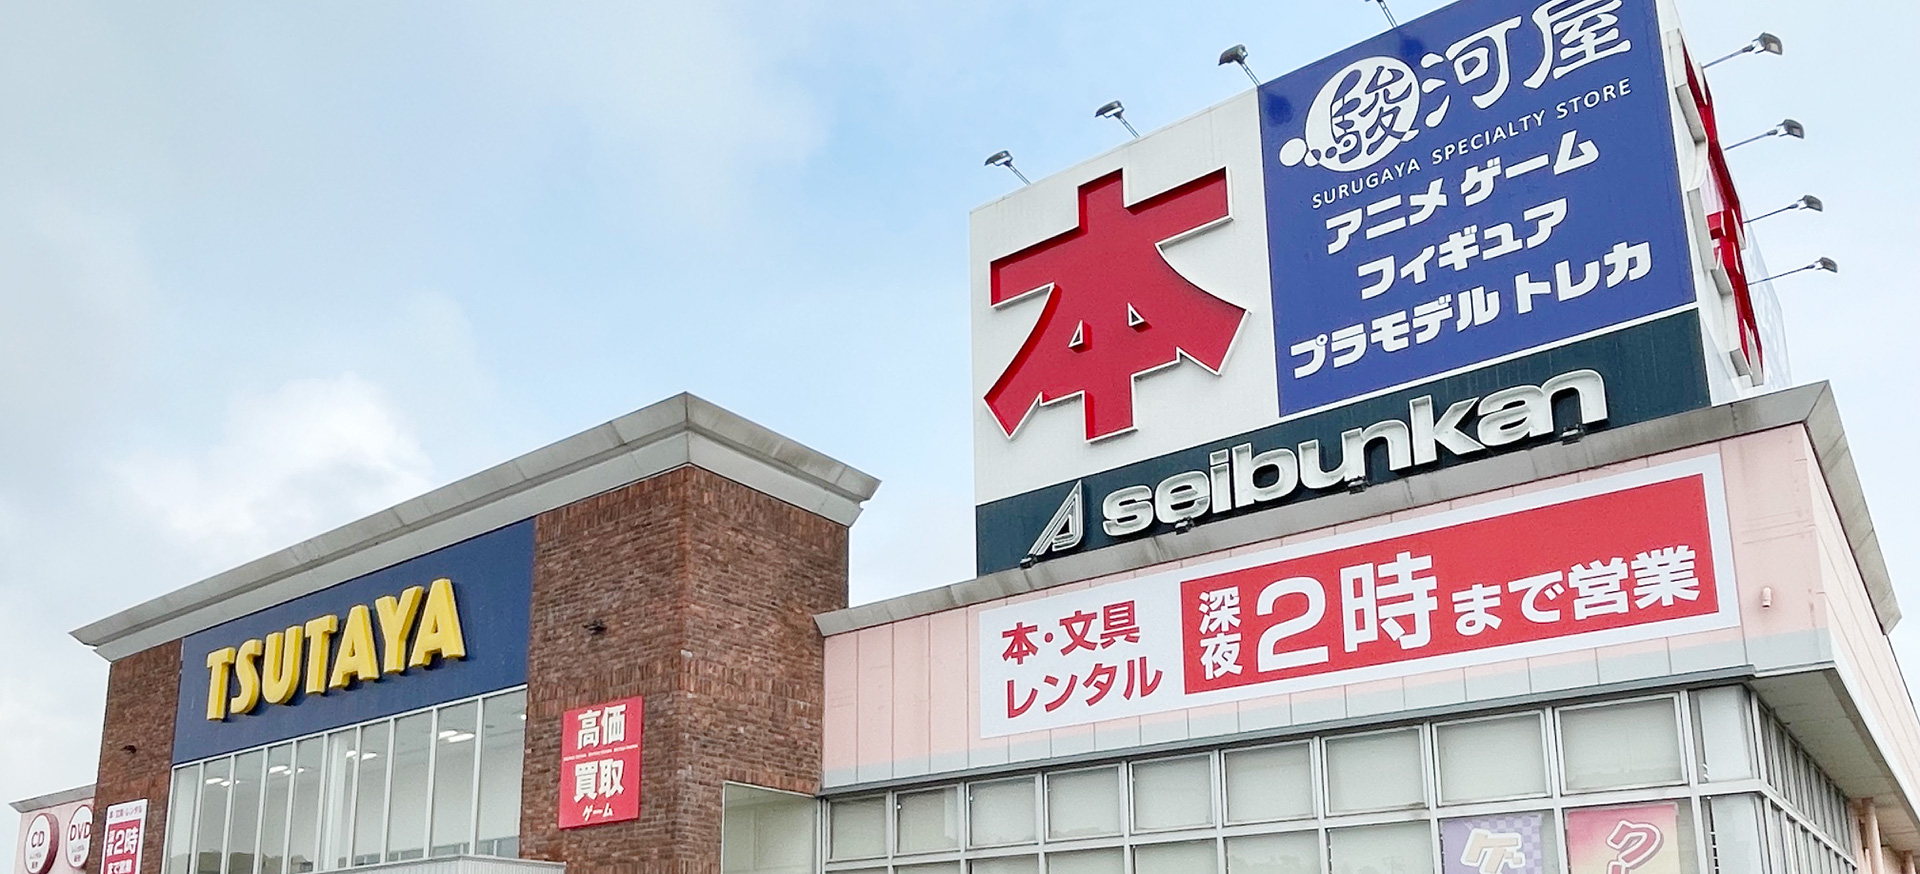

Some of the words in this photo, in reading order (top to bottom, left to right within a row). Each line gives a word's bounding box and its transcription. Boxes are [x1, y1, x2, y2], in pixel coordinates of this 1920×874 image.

[1304, 0, 1632, 166] 駿河屋
[1312, 157, 1420, 209] SURUGAYA
[1432, 110, 1545, 165] SPECIALTY
[1556, 78, 1632, 119] STORE
[1326, 178, 1447, 254] アニメ
[1461, 130, 1599, 206] ゲーム
[1358, 198, 1567, 300] フィギュア
[984, 166, 1251, 443] 本
[1290, 285, 1500, 379] プラモデル
[1515, 240, 1652, 314] トレカ
[1102, 368, 1607, 537] seibunkan
[206, 577, 467, 722] TSUTAYA
[1001, 599, 1142, 666] 本・文具
[1199, 589, 1243, 681] 深夜
[577, 704, 626, 750] 高価
[1006, 656, 1162, 719] レンタル
[574, 758, 624, 803] 買取
[583, 802, 613, 821] ゲーム
[31, 830, 45, 848] CD
[70, 822, 91, 841] DVD
[1606, 819, 1664, 874] ク
